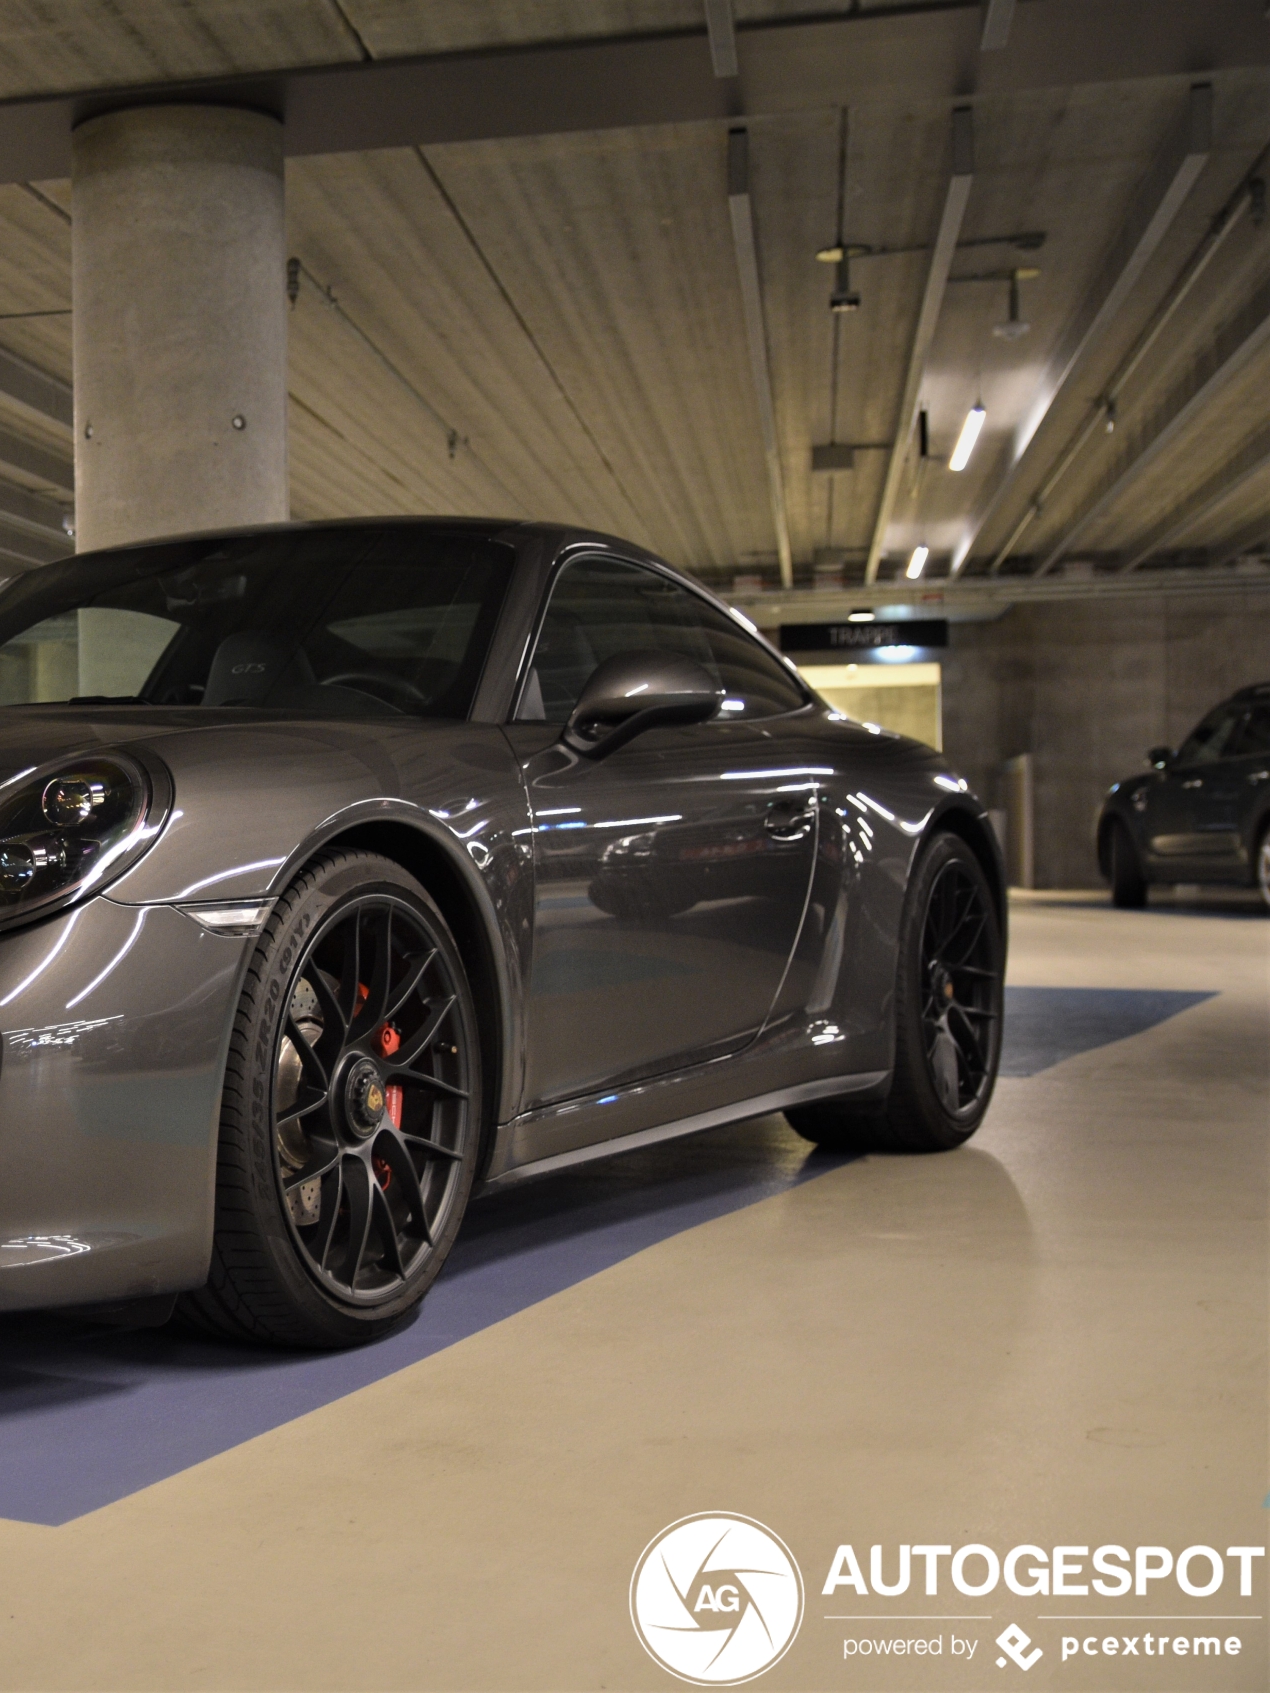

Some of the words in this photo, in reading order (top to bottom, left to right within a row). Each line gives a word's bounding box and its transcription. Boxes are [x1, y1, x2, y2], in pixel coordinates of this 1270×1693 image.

[232, 663, 266, 674] GTS
[255, 978, 280, 1073] ZR20
[279, 912, 312, 975] (91Y)
